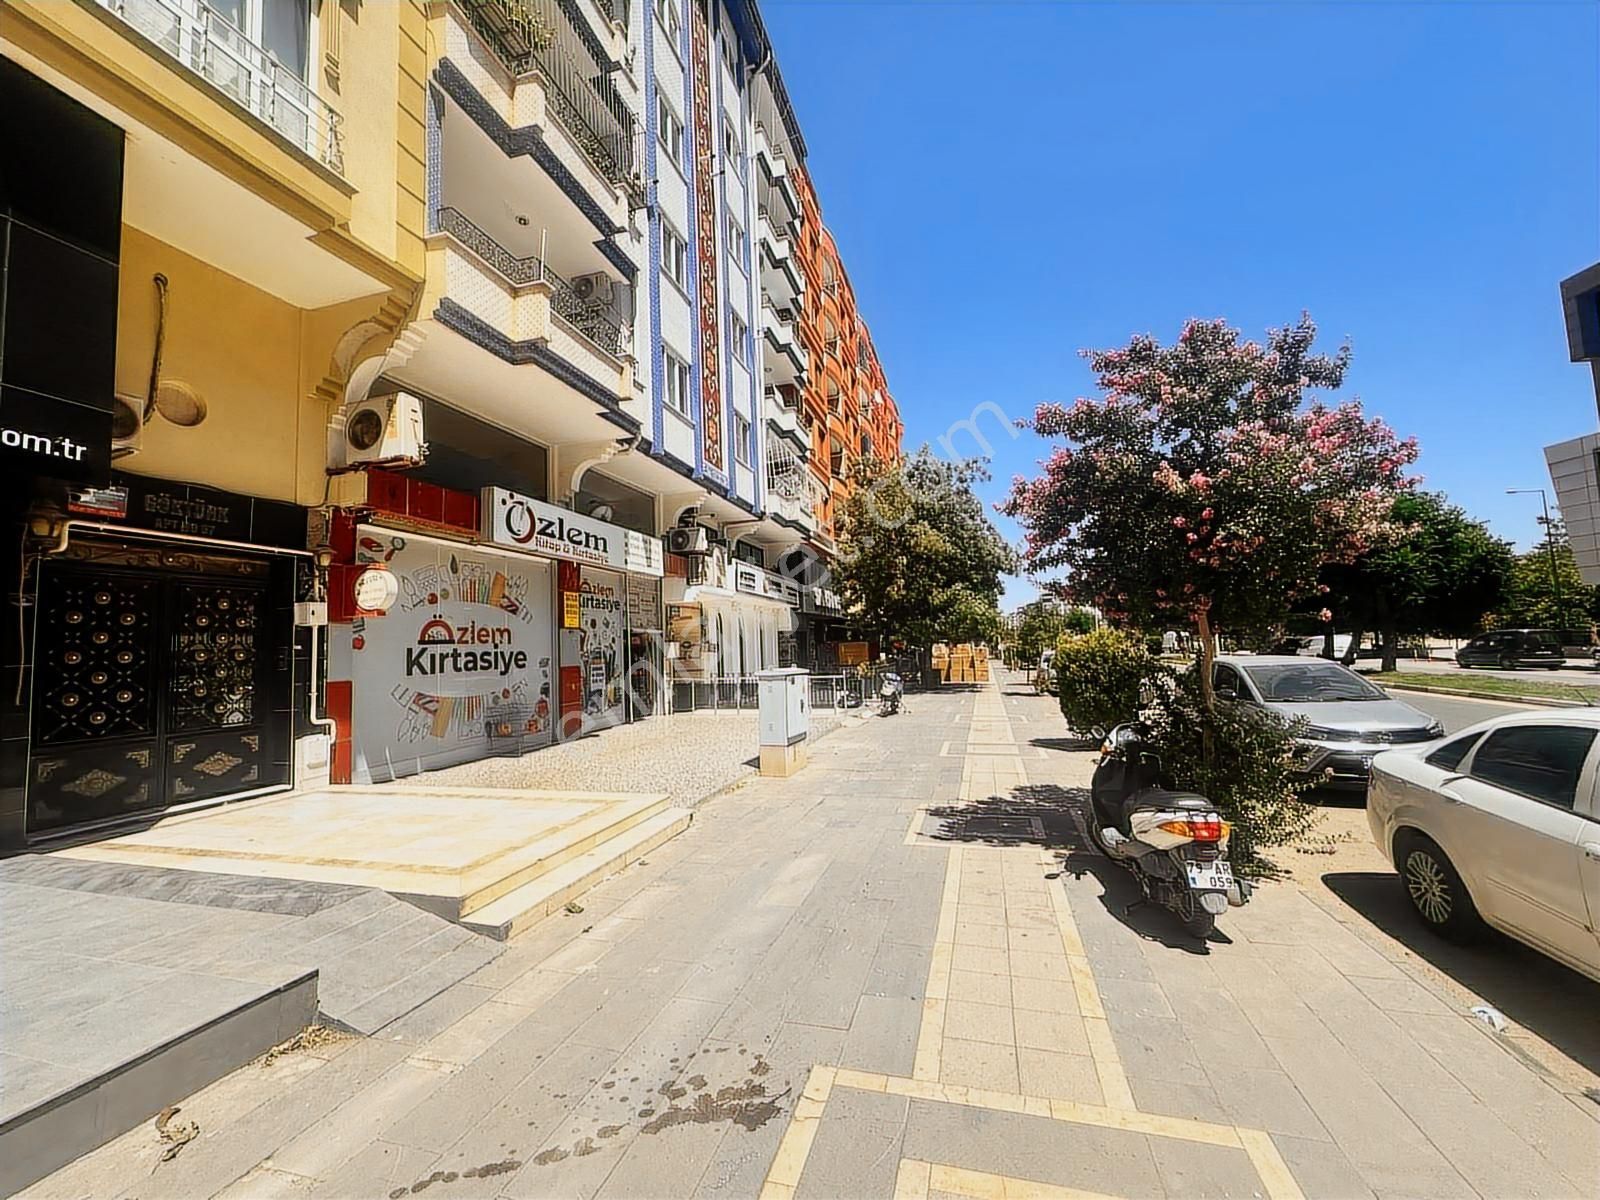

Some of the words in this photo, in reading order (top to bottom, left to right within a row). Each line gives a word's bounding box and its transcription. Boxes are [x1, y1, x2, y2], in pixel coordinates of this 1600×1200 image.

[501, 492, 609, 553] Özlem
[418, 614, 512, 645] Özlem
[406, 645, 528, 676] Kırtasiye
